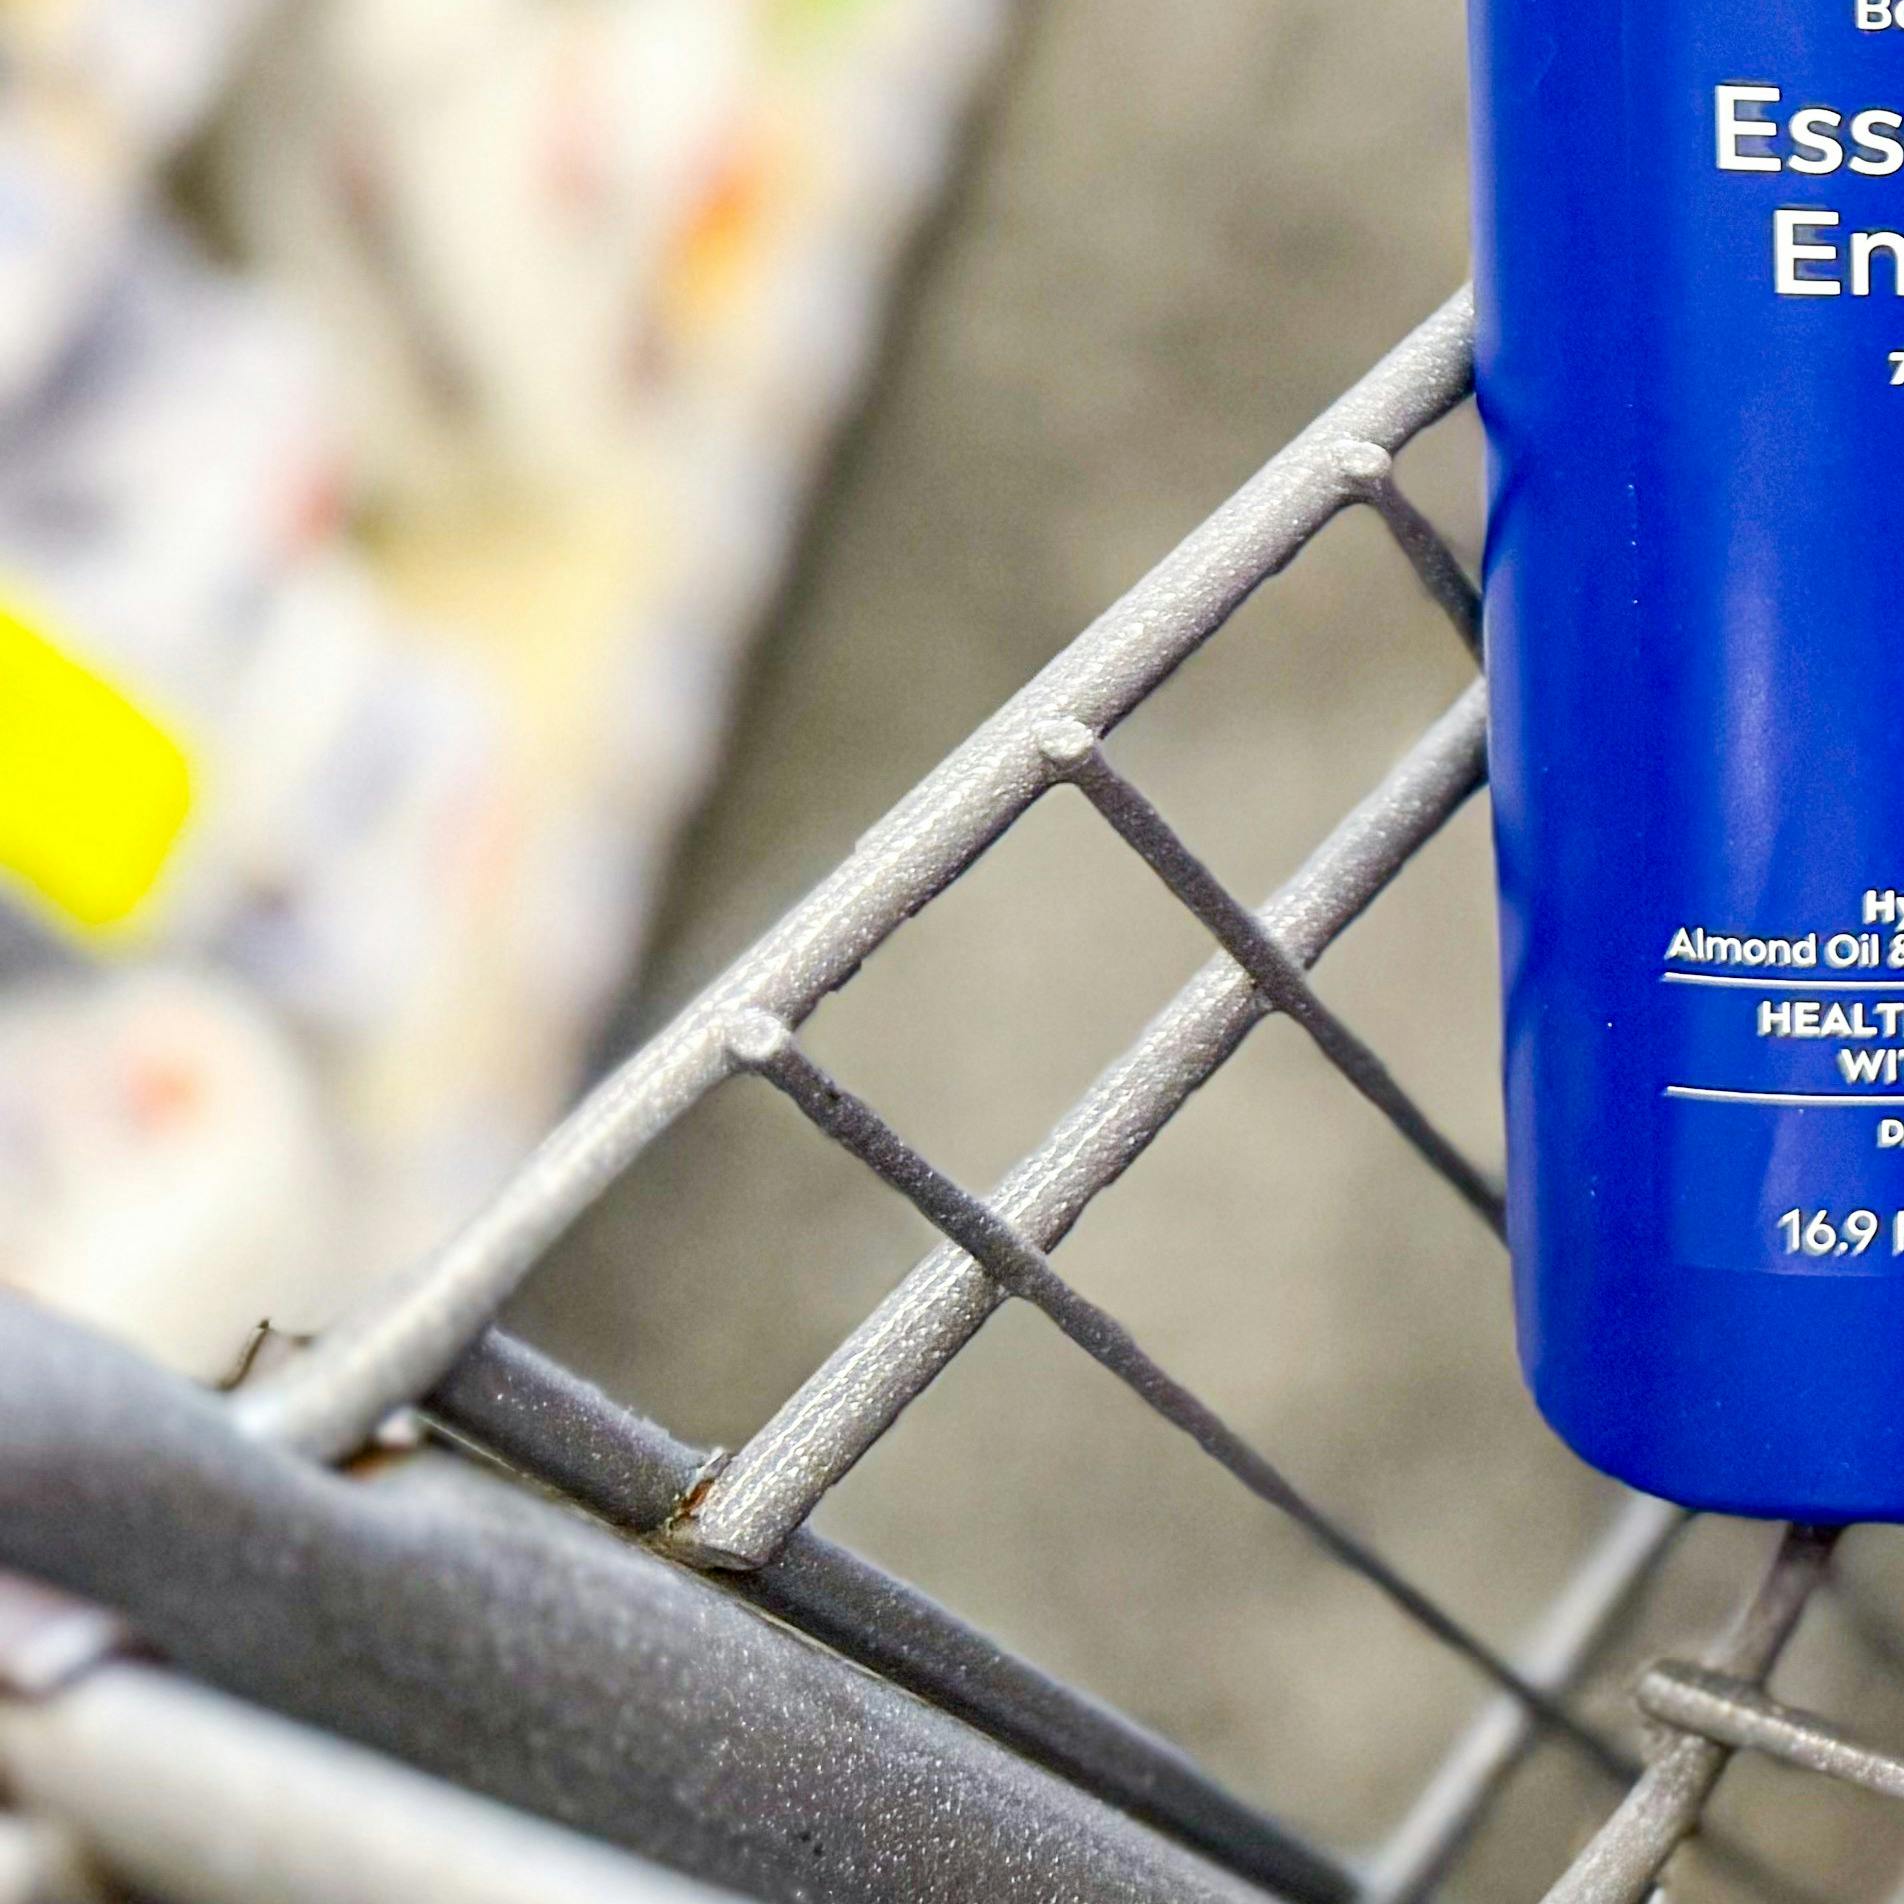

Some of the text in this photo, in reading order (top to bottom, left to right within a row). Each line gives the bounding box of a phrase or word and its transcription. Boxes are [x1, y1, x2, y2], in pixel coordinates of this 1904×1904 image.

[1667, 928, 1816, 966] Almond
[1825, 933, 1880, 967] Oil
[1778, 1209, 1877, 1255] 16.9
